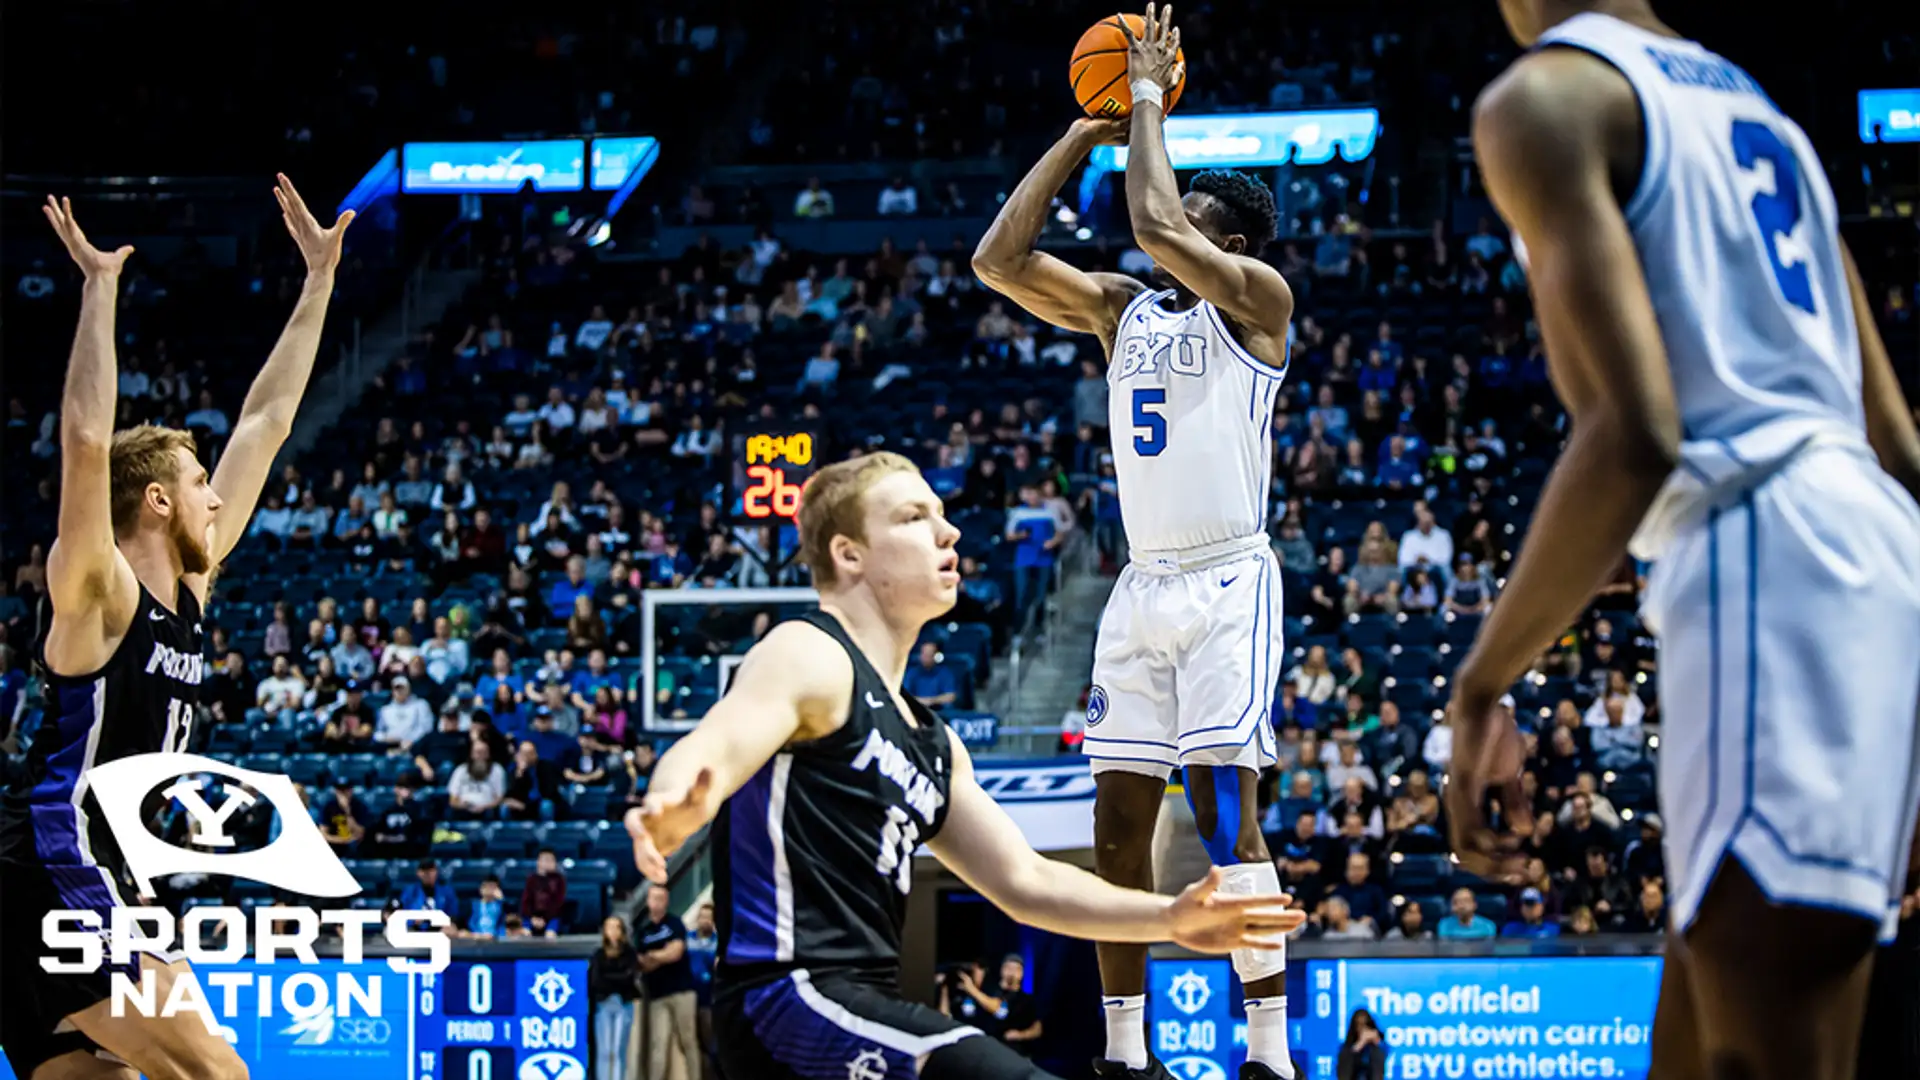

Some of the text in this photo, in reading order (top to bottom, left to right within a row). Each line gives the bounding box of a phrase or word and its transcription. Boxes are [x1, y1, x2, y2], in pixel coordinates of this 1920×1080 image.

[1731, 119, 1818, 316] 2
[1118, 333, 1207, 381] BYU
[1133, 388, 1167, 456] 5
[746, 433, 812, 464] 19:40
[744, 466, 801, 517] 26
[468, 964, 492, 1014] 0
[1362, 984, 1541, 1016] The official
[446, 1020, 494, 1042] PERIOD
[520, 1016, 576, 1049] 19:40
[1157, 1019, 1216, 1052] 19:40
[1385, 1021, 1539, 1047] ometown
[1402, 1053, 1466, 1080] BYU
[1472, 1050, 1625, 1080] athletics.
